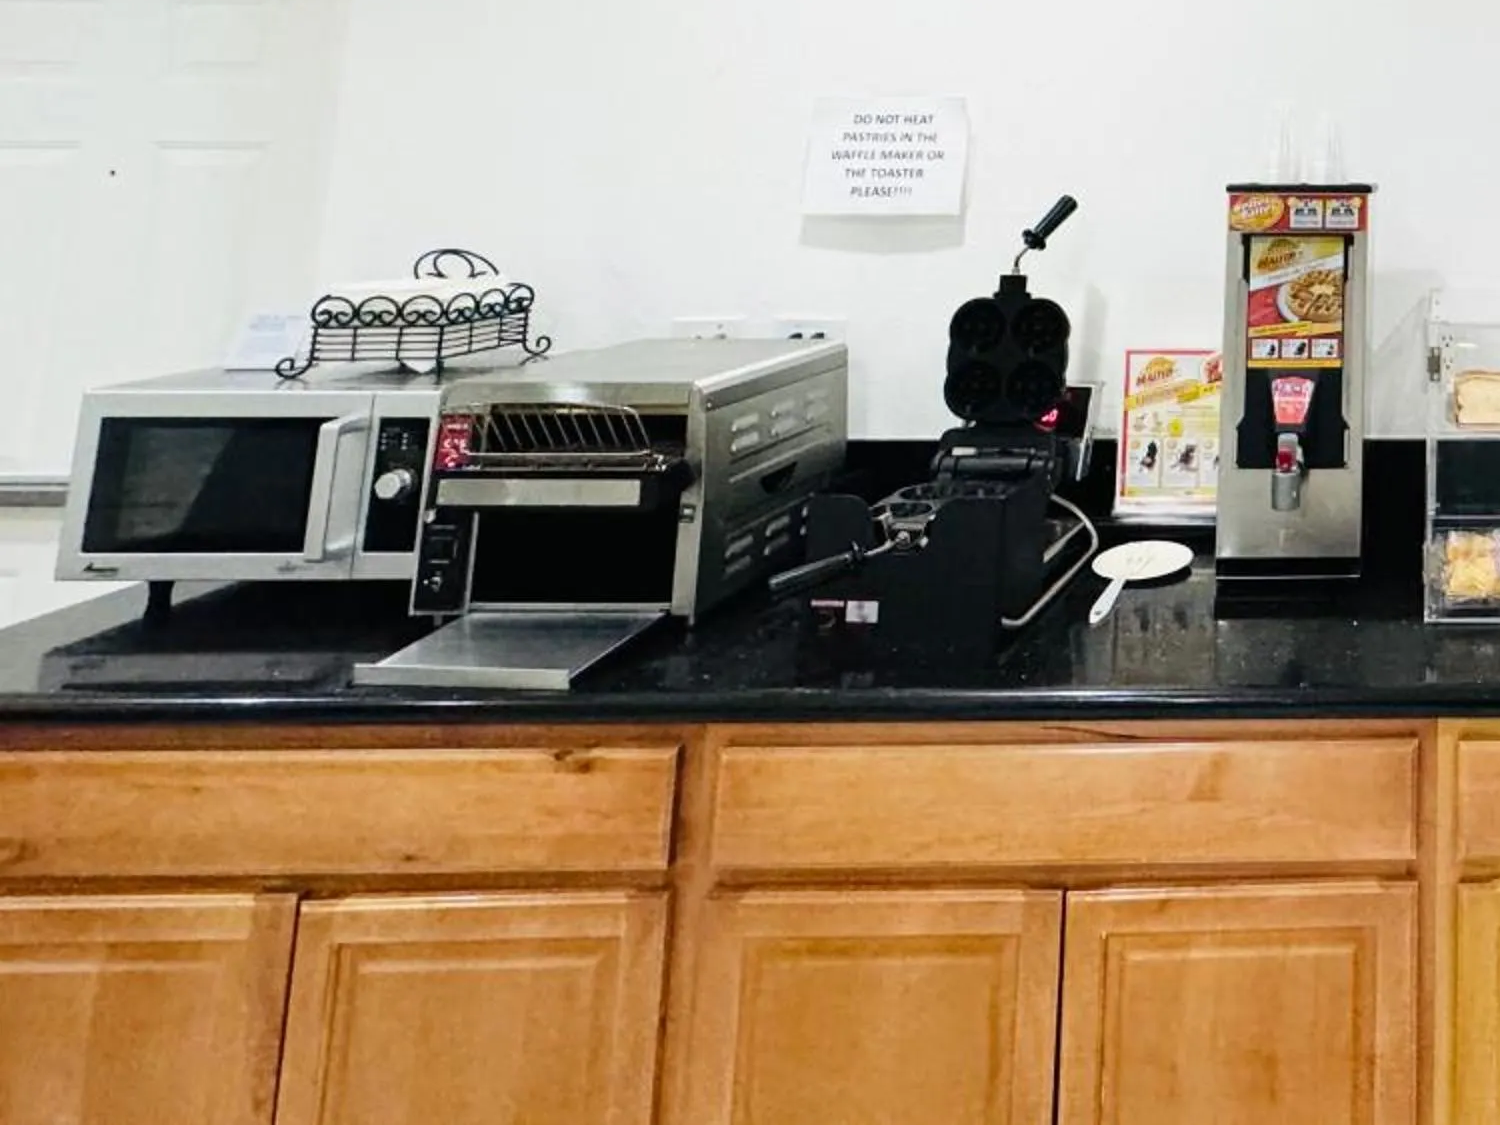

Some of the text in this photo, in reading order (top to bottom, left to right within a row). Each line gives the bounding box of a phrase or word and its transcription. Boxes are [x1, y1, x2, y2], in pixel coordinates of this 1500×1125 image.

[853, 114, 934, 124] DO NOT HEAT
[843, 132, 937, 142] PASTRIES IN THE
[831, 150, 945, 160] WAFFLE MAKER OR
[845, 168, 924, 179] THE TOASTER
